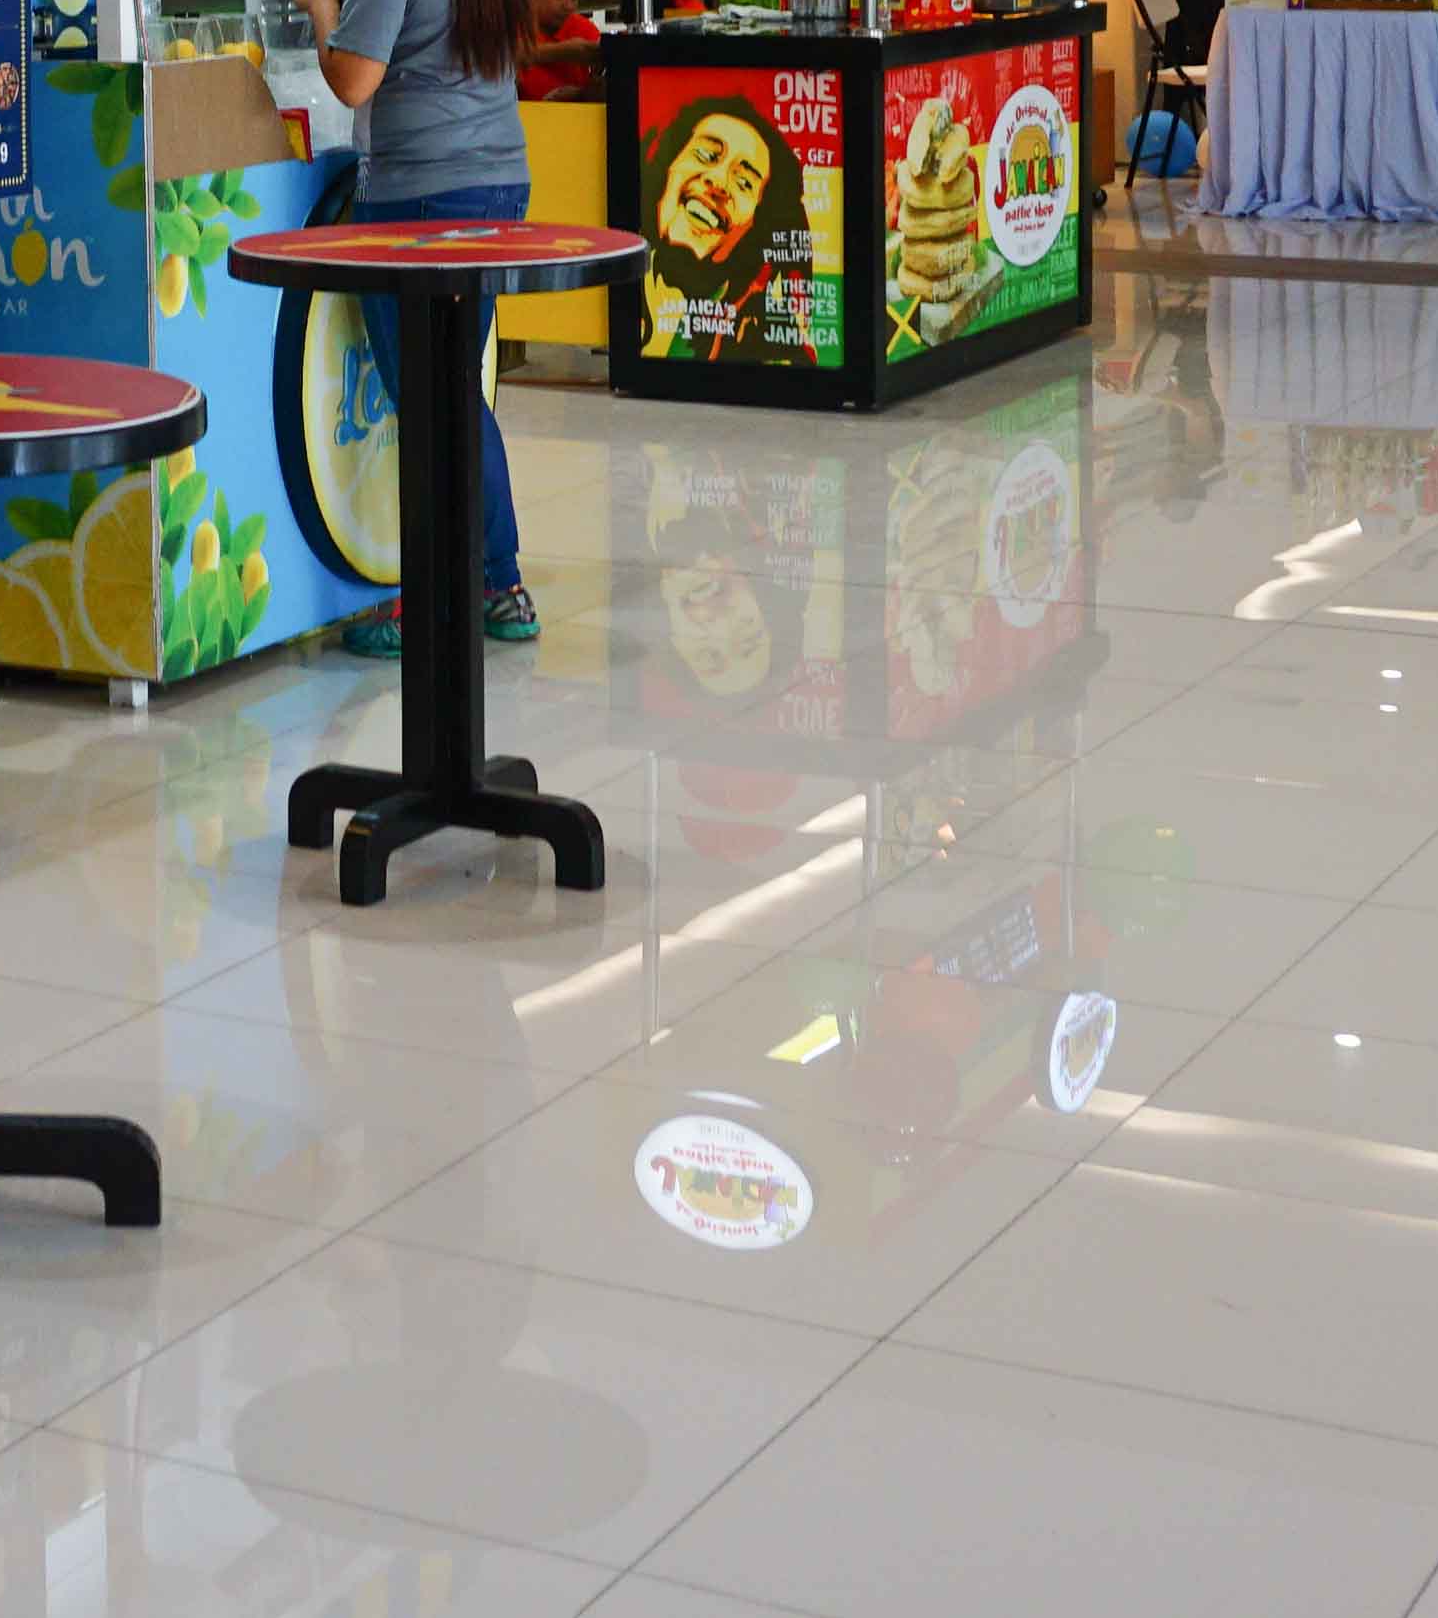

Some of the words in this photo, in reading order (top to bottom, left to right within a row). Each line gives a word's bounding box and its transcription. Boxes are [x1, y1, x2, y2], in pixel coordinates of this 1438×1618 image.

[773, 71, 837, 103] ONE
[773, 102, 838, 135] LOVE
[807, 147, 835, 166] GET
[994, 142, 1066, 210] JAMAICAN
[656, 296, 738, 319] JAMAICA'S
[764, 295, 837, 317] RECIPES
[692, 317, 737, 337] SNACK
[763, 323, 840, 347] JAMAICA
